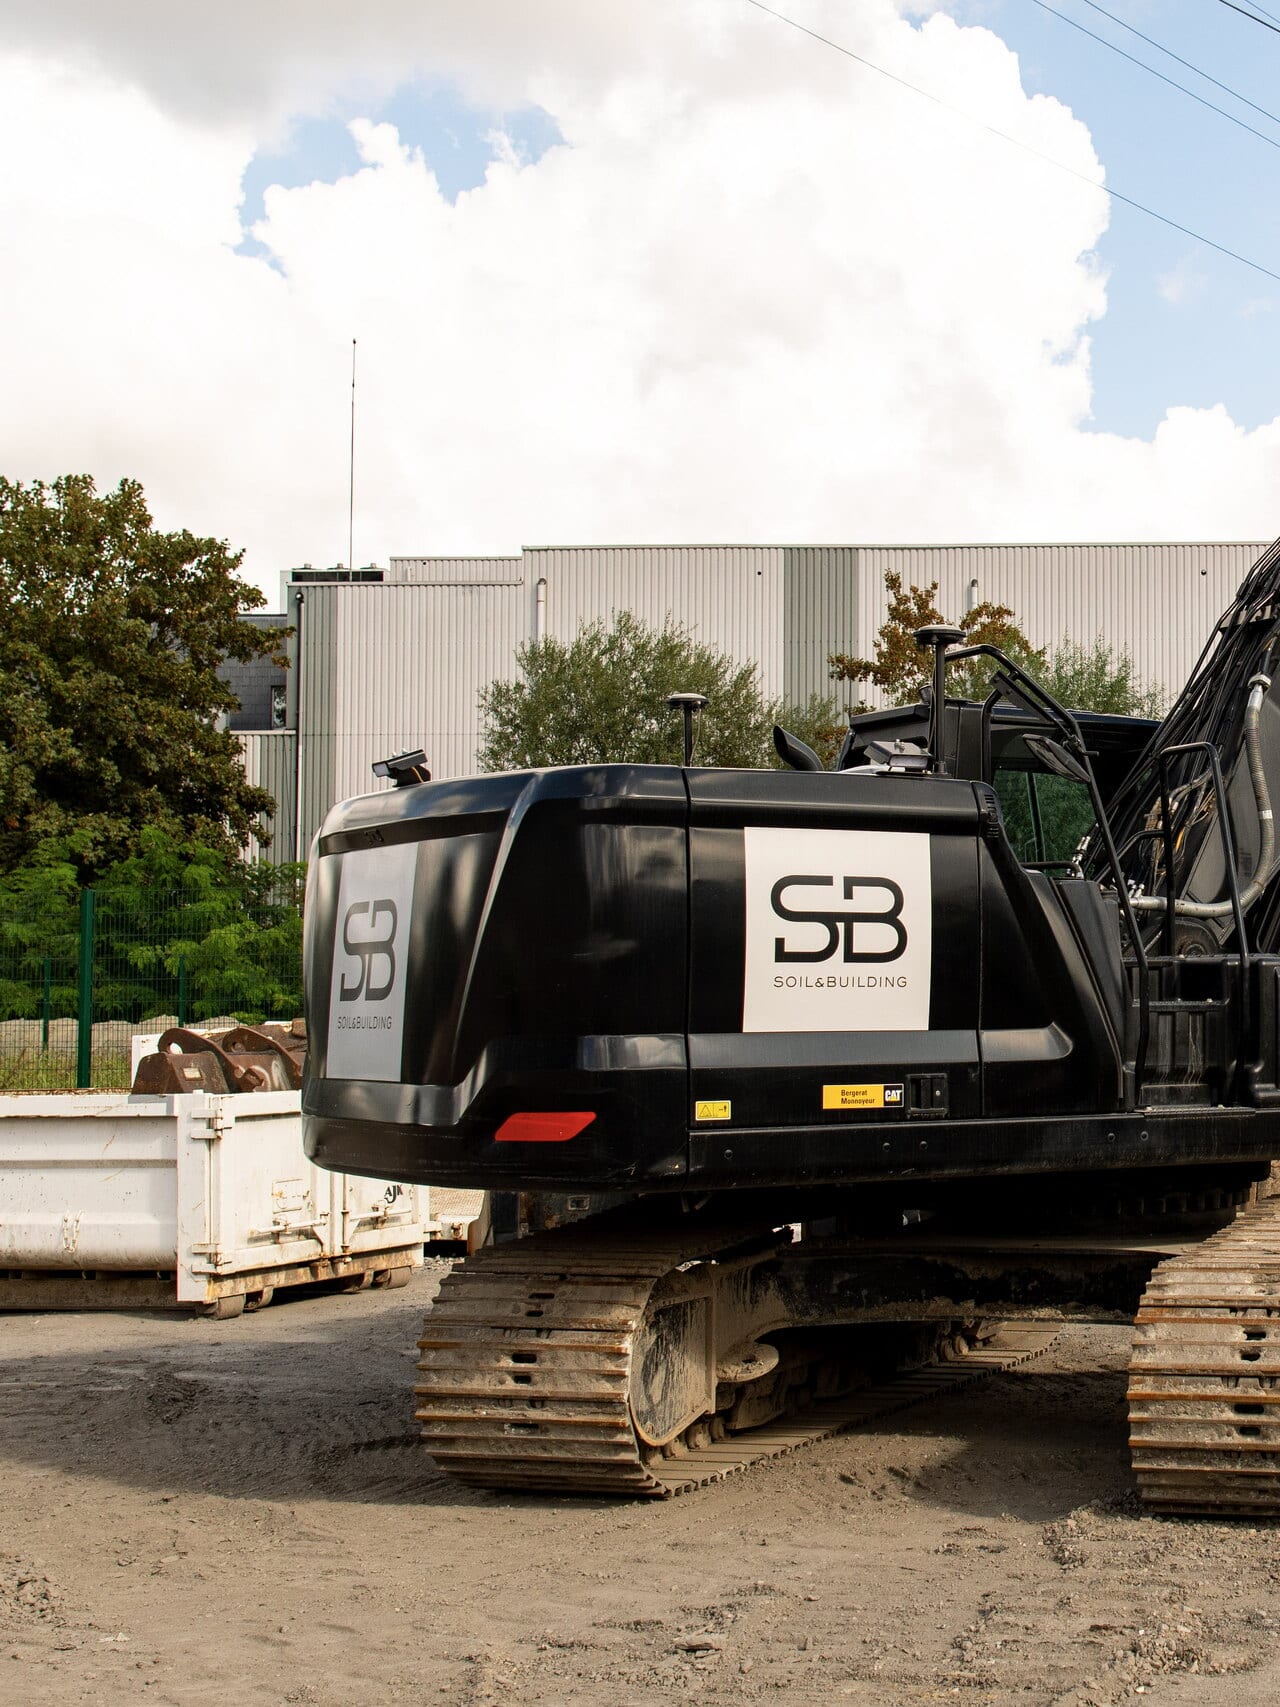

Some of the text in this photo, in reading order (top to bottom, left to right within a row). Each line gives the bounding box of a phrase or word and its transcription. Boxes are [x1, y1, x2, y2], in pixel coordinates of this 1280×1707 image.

[770, 874, 908, 964] SB
[339, 898, 399, 1002] SB
[773, 975, 908, 989] SOIL&BUILDING
[336, 1015, 393, 1030] SOIL&BUILDING
[841, 1089, 868, 1098] Bergerat
[884, 1089, 902, 1102] CAT
[840, 1097, 876, 1106] Monnoyeur
[383, 1183, 404, 1204] AJK
